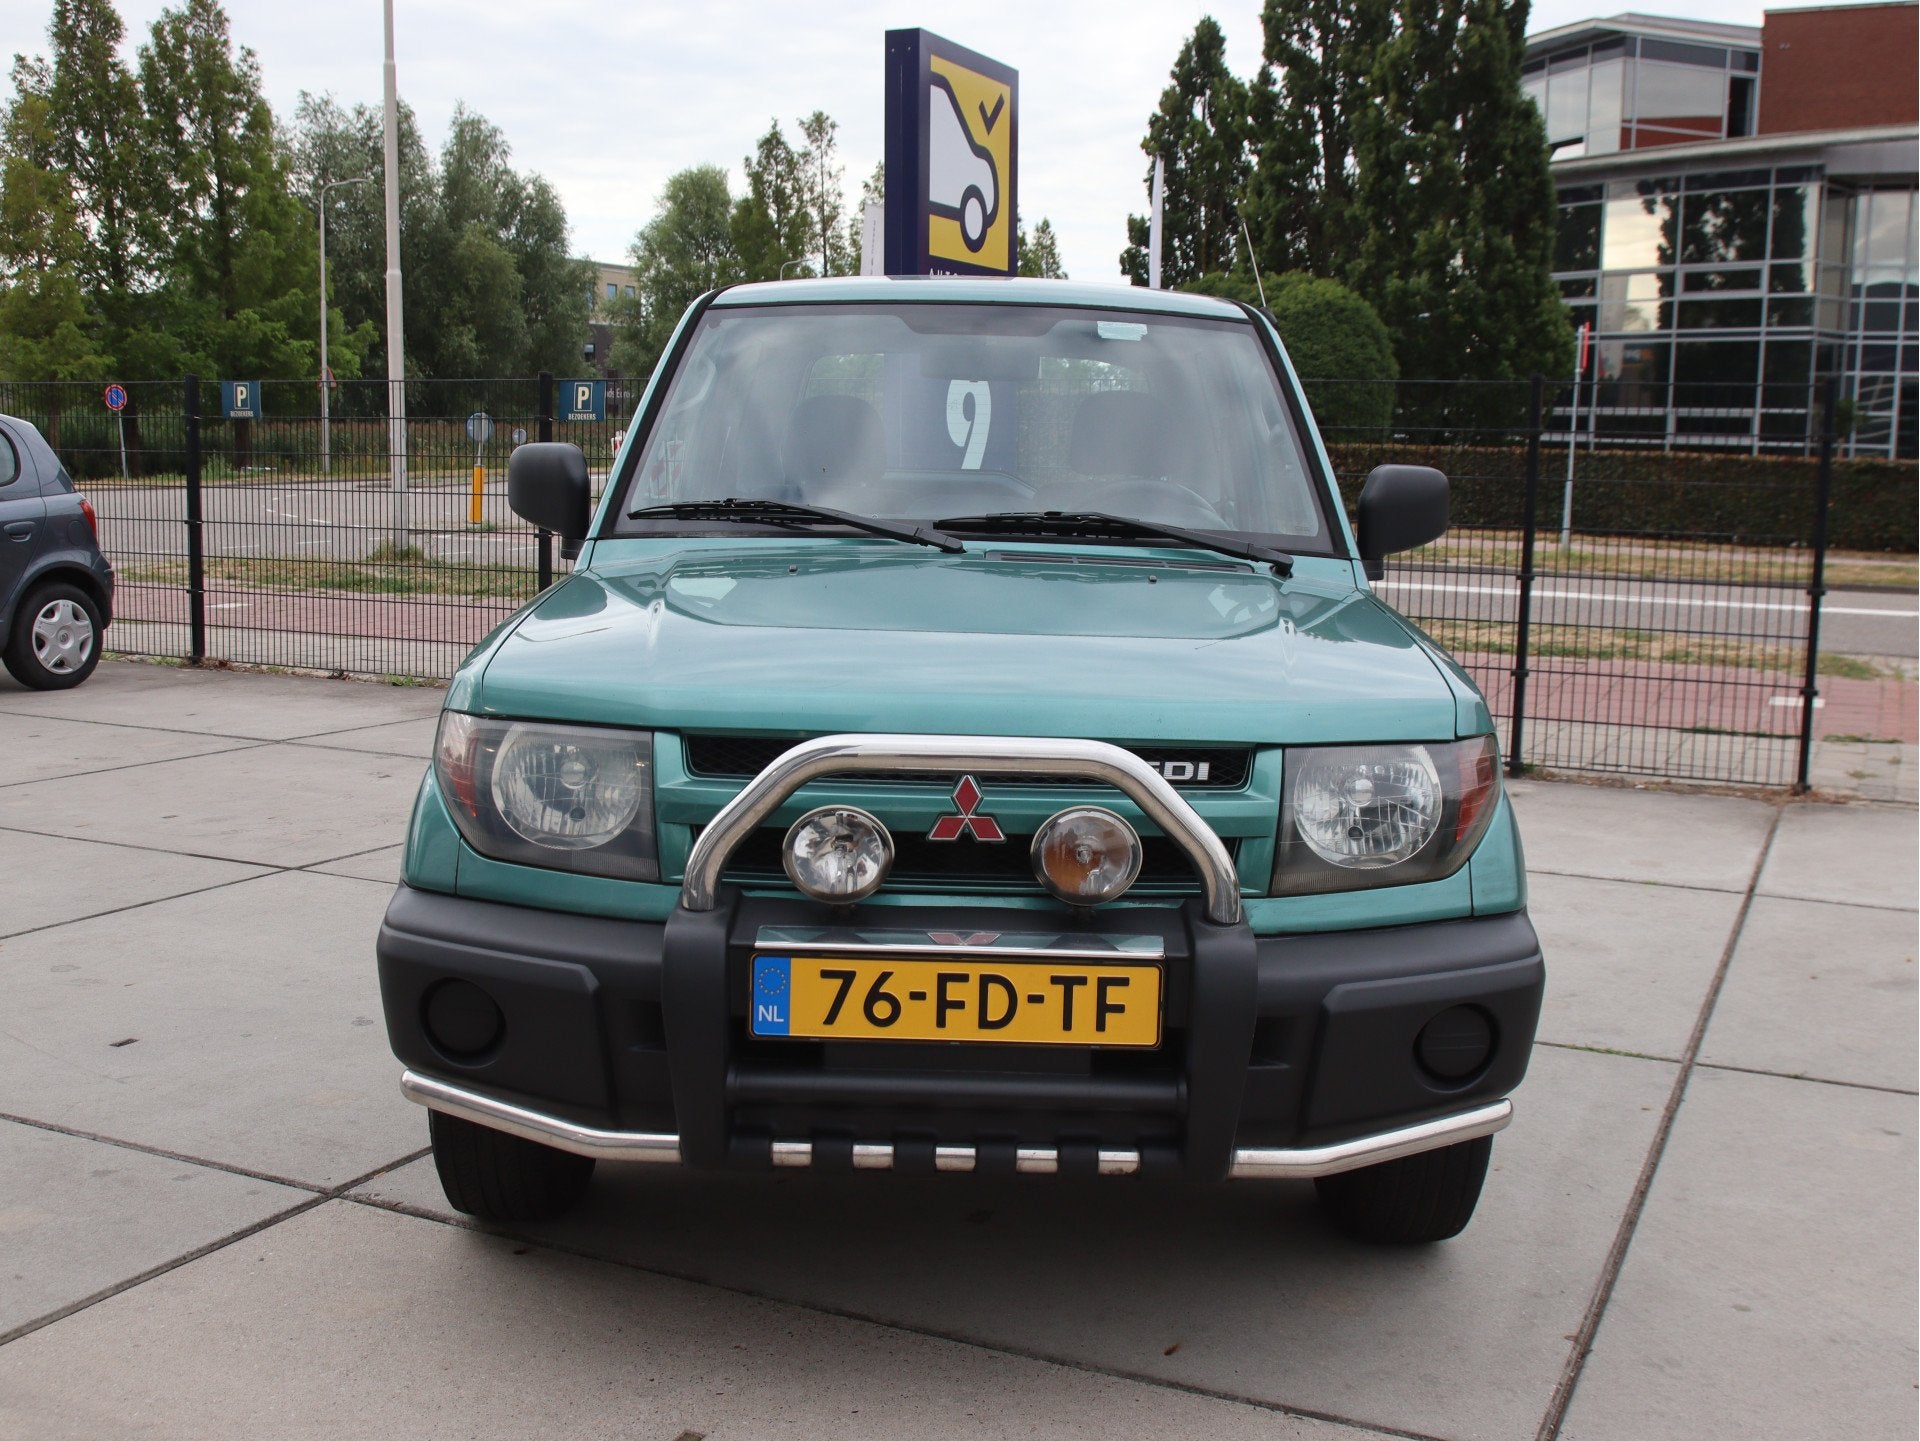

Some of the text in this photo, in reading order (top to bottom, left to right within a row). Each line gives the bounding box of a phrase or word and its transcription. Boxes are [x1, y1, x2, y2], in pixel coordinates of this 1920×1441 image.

[236, 386, 247, 407] P
[577, 386, 590, 409] P
[819, 969, 1130, 1032] 76-FD-TF
[758, 1004, 785, 1023] NL
